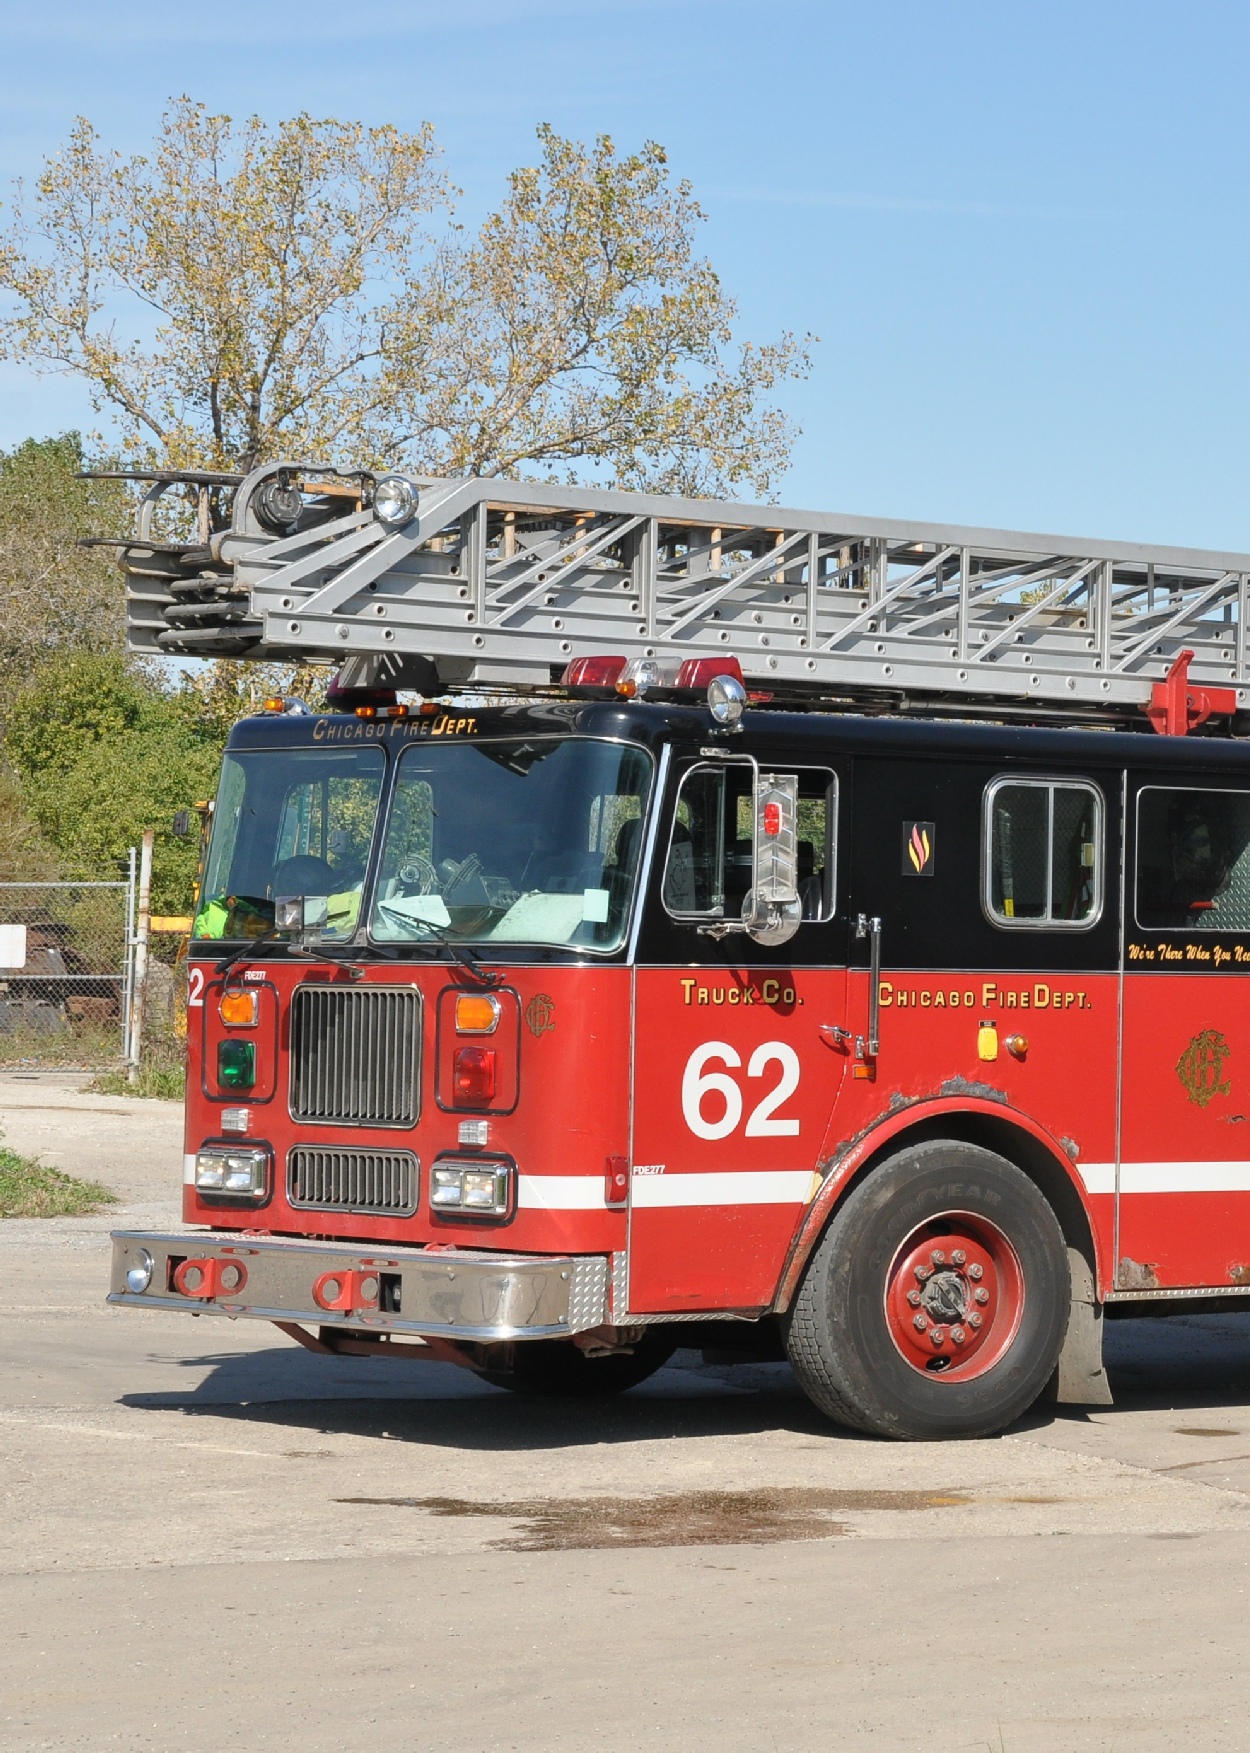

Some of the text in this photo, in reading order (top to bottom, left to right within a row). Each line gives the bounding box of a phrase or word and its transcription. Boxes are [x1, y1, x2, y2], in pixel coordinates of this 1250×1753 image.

[313, 714, 479, 740] CHICAGO FIRE DEPT.
[1129, 944, 1155, 960] We're
[1157, 944, 1183, 961] There
[1186, 944, 1211, 960] When
[1213, 945, 1231, 967] You
[187, 966, 204, 1006] 2
[680, 979, 804, 1005] TRUCK CO.
[878, 982, 1093, 1009] CHICAGO FIRE DEPT.
[681, 1040, 800, 1140] 62
[633, 1164, 666, 1175] FDE277
